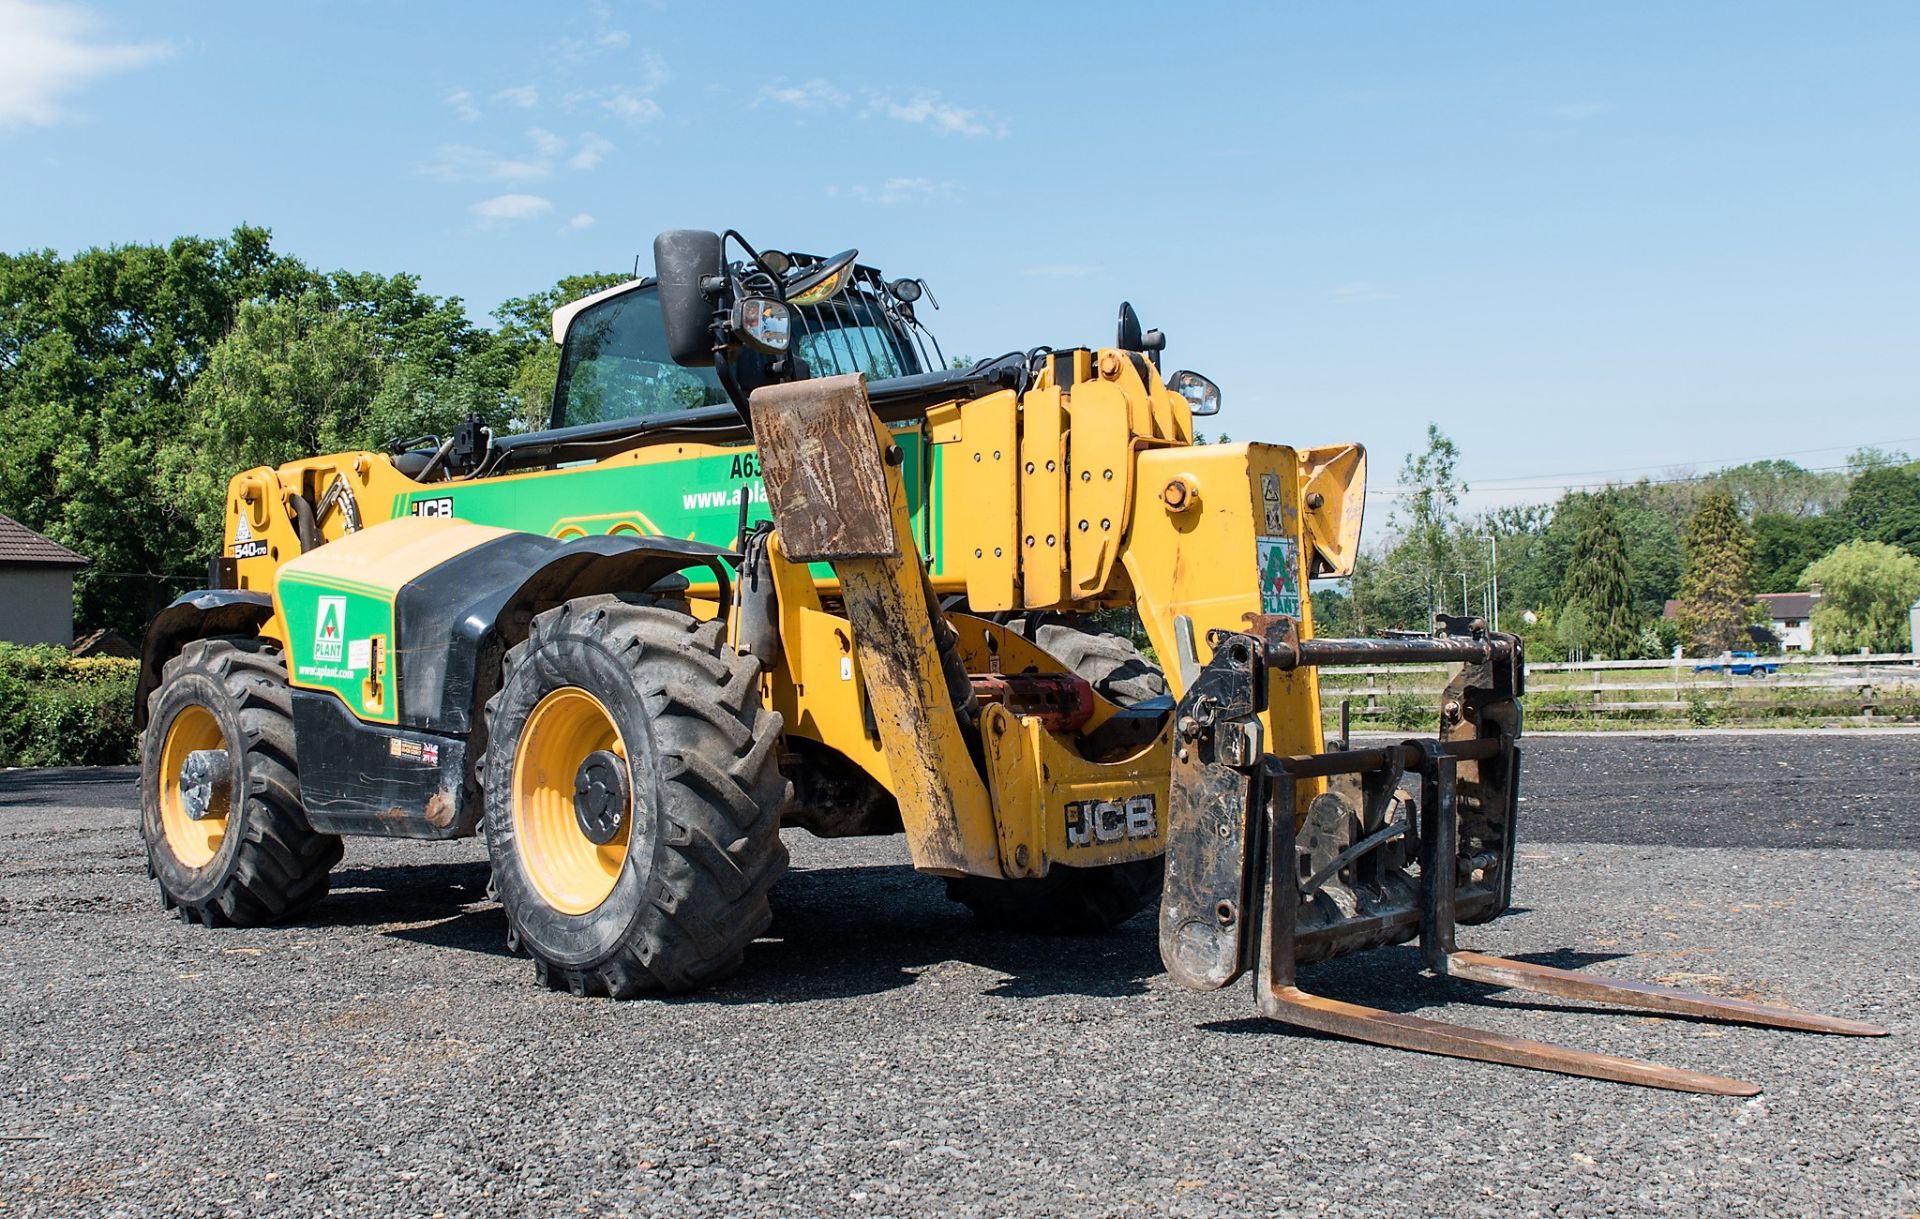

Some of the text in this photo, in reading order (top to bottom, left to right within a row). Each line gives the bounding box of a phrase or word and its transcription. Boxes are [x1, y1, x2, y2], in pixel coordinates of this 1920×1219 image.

[412, 498, 452, 518] JCB
[319, 603, 341, 639] A
[315, 643, 341, 657] PLANT
[1068, 798, 1156, 844] JCB
